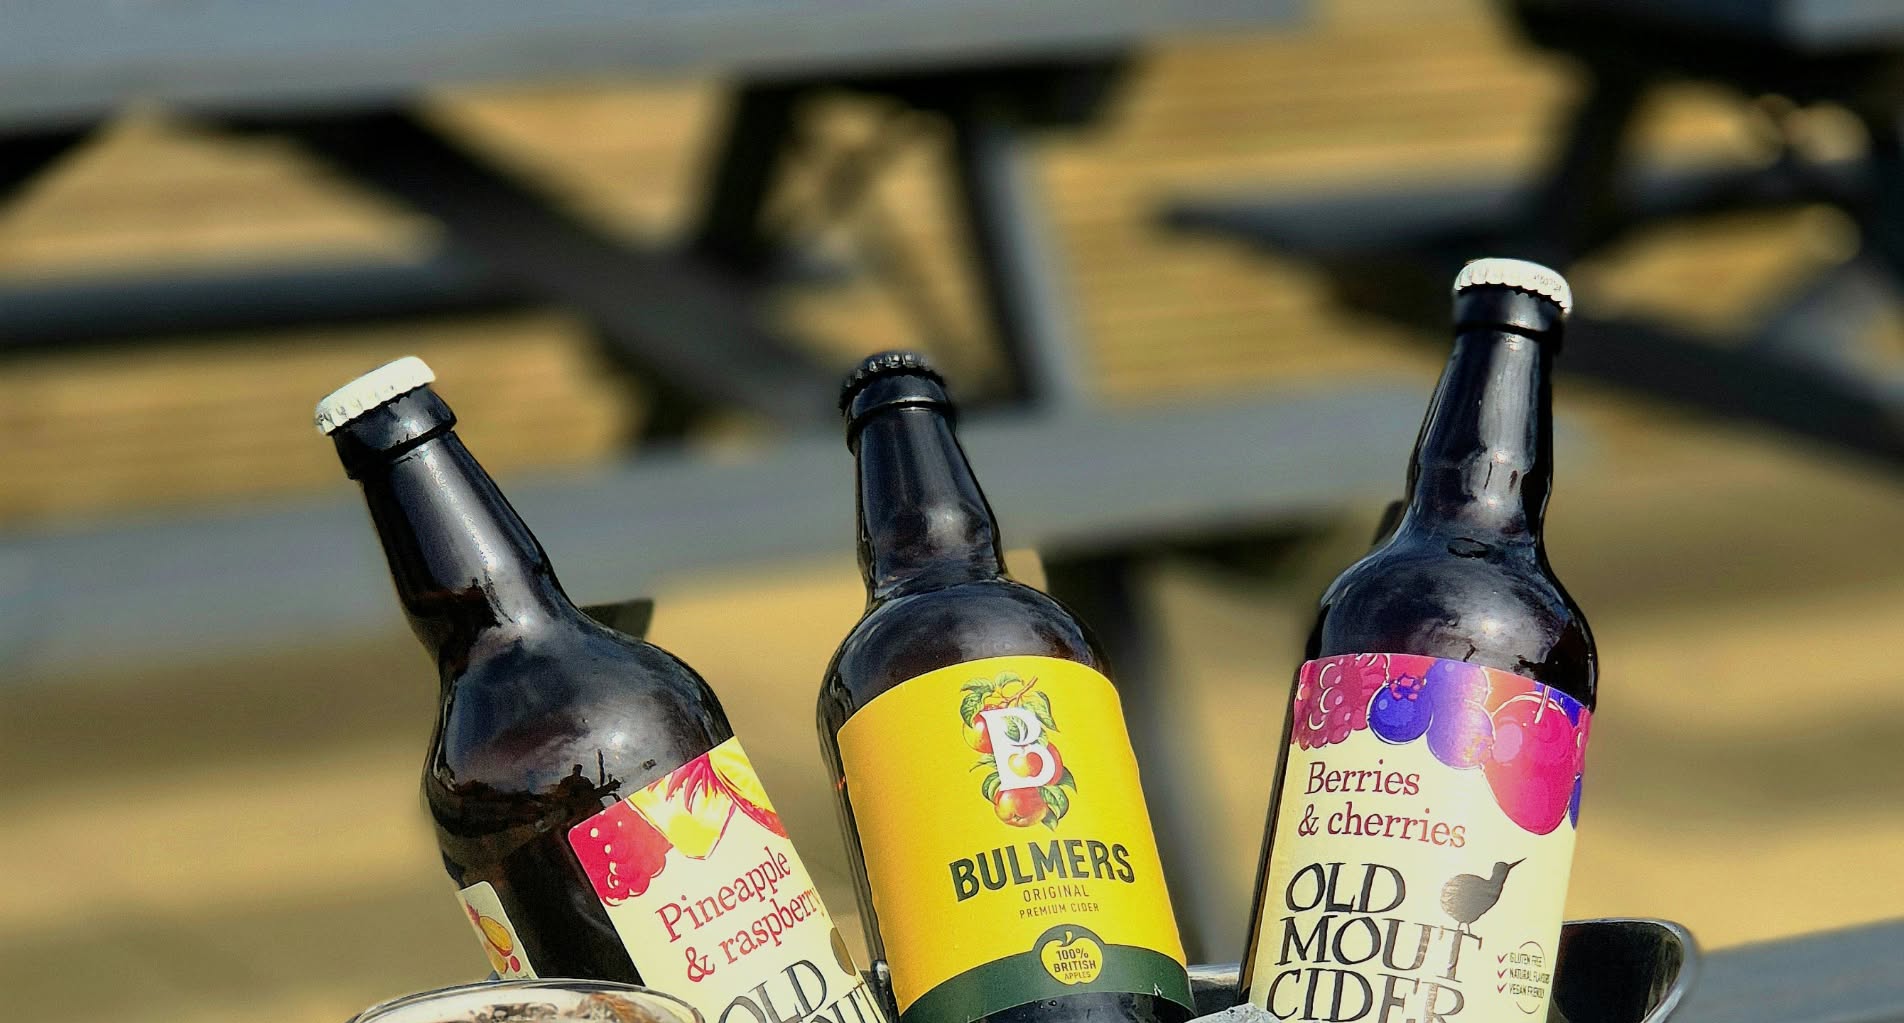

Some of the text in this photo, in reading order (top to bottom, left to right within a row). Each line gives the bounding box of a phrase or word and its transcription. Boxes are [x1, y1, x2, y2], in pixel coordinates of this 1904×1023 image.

[1304, 759, 1420, 796] Berries
[1297, 801, 1466, 849] & cherries
[948, 839, 1136, 902] BULMERS
[1285, 862, 1406, 913] OLD
[655, 845, 791, 943] Pineapple
[1019, 902, 1099, 919] PREMIUM CIDER
[1023, 884, 1090, 902] ORIGINAL
[685, 946, 716, 983] &
[1053, 959, 1097, 973] BRITISH
[1056, 947, 1089, 961] 100%
[1274, 914, 1483, 983] MOUT
[1064, 971, 1091, 980] APPLES
